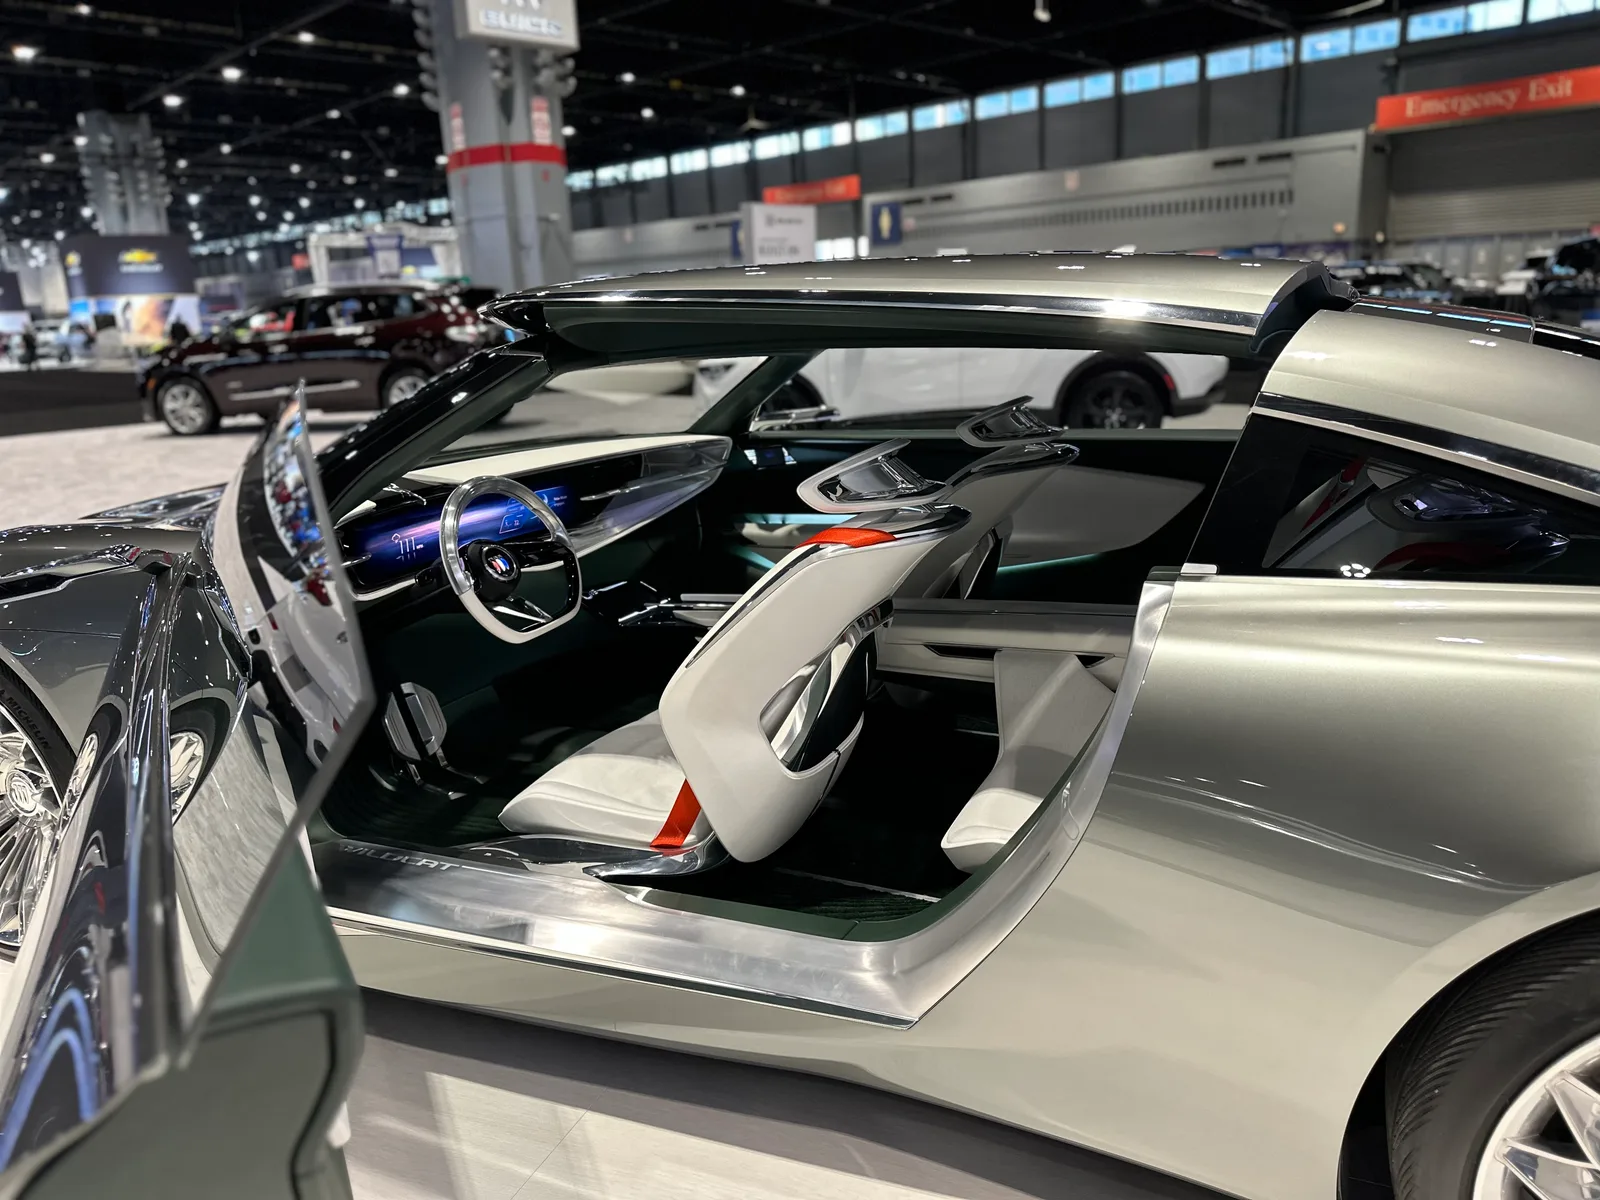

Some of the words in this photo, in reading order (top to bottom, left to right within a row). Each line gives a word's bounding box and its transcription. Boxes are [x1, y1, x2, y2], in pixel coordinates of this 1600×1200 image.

[1405, 88, 1520, 117] Emergency
[1528, 76, 1573, 101] Exit
[7, 697, 52, 749] MICHELIN
